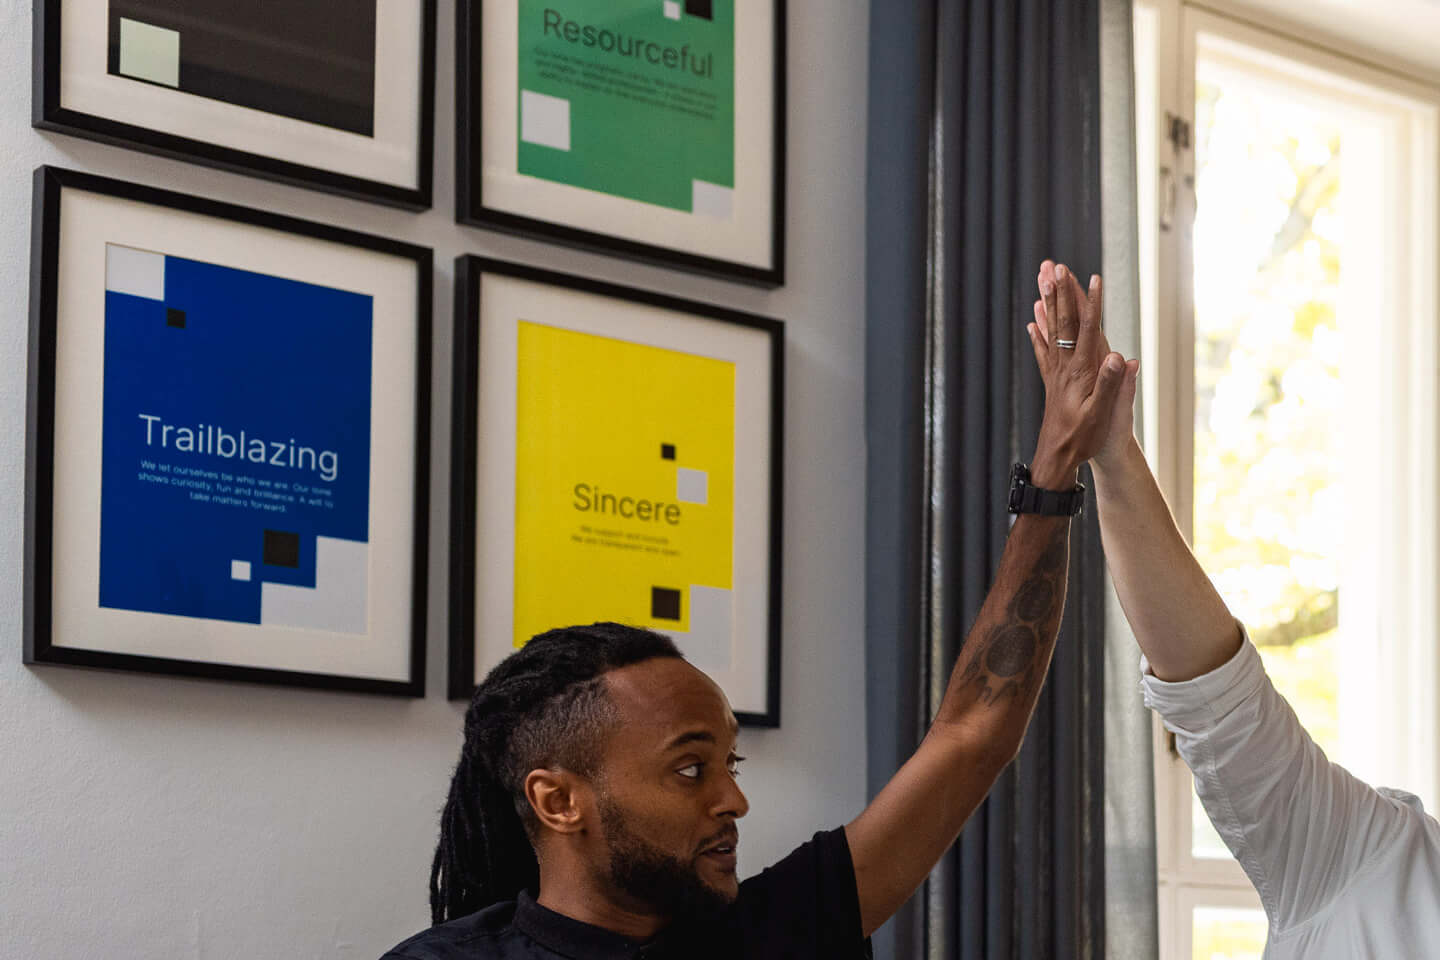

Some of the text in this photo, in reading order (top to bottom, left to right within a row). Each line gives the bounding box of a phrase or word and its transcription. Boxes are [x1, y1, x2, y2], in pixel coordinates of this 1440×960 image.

[543, 7, 714, 79] Resourceful
[138, 413, 339, 481] Trailblazing
[138, 472, 169, 484] shows
[216, 483, 232, 492] fun
[234, 487, 251, 497] and
[140, 459, 156, 471] We
[158, 463, 171, 472] let
[173, 465, 218, 479] ourselves
[221, 472, 233, 481] be
[236, 475, 256, 485] who
[258, 479, 271, 487] we
[293, 483, 309, 492] Our
[573, 483, 681, 525] Sincere
